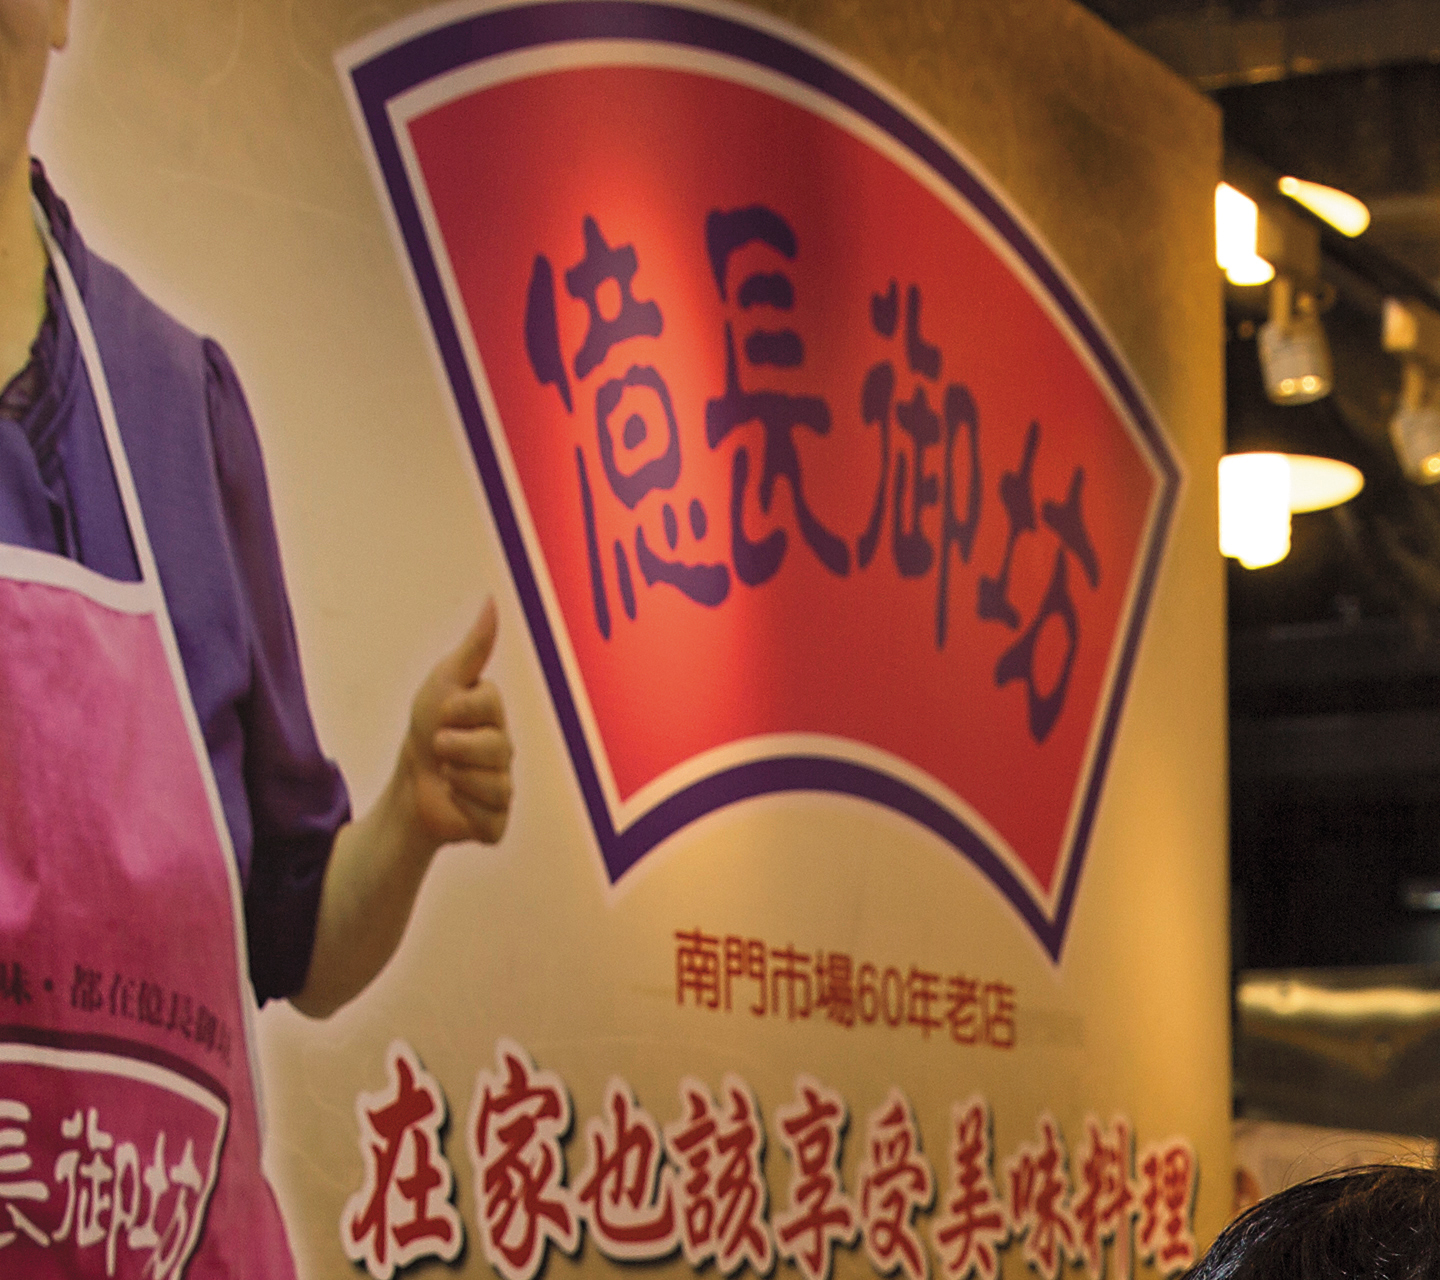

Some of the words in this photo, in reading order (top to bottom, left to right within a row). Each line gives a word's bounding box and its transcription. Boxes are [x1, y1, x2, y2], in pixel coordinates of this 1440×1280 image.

[523, 204, 1101, 746] 億長御坊
[673, 928, 1019, 1052] 南門市場60年老店
